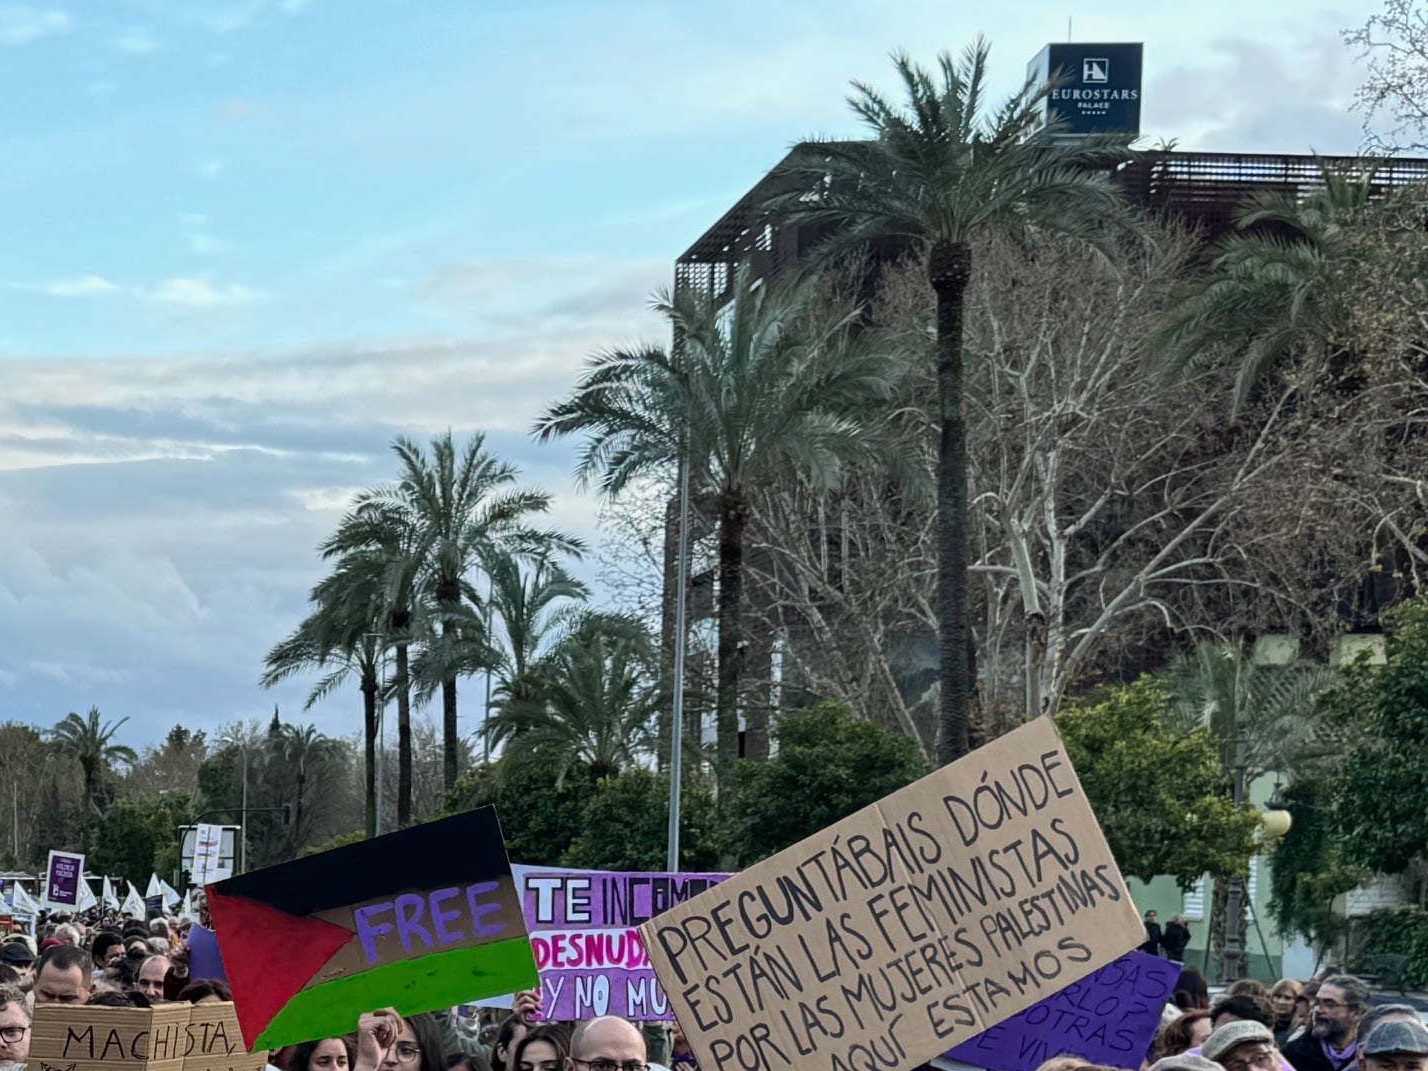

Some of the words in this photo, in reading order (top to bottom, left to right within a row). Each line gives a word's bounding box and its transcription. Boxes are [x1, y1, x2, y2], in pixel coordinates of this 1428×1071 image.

[1052, 89, 1138, 100] EUROSTARS
[526, 877, 592, 924] TE
[657, 812, 942, 984] PREGUNTÁBAIS
[943, 750, 1074, 848] DÓNDE
[354, 880, 507, 964] FREE
[682, 943, 803, 1032] ESTÁN
[798, 913, 874, 984] LAS
[867, 818, 1081, 955] FEMINISTAS
[781, 992, 845, 1057] LAS
[843, 927, 984, 1032] MUJERES
[981, 864, 1121, 957] PALESTINAS
[545, 976, 565, 1020] Y
[574, 973, 610, 1020] NO
[927, 936, 1093, 1040] ESTAMOS
[62, 1021, 237, 1061] MACHISTA,
